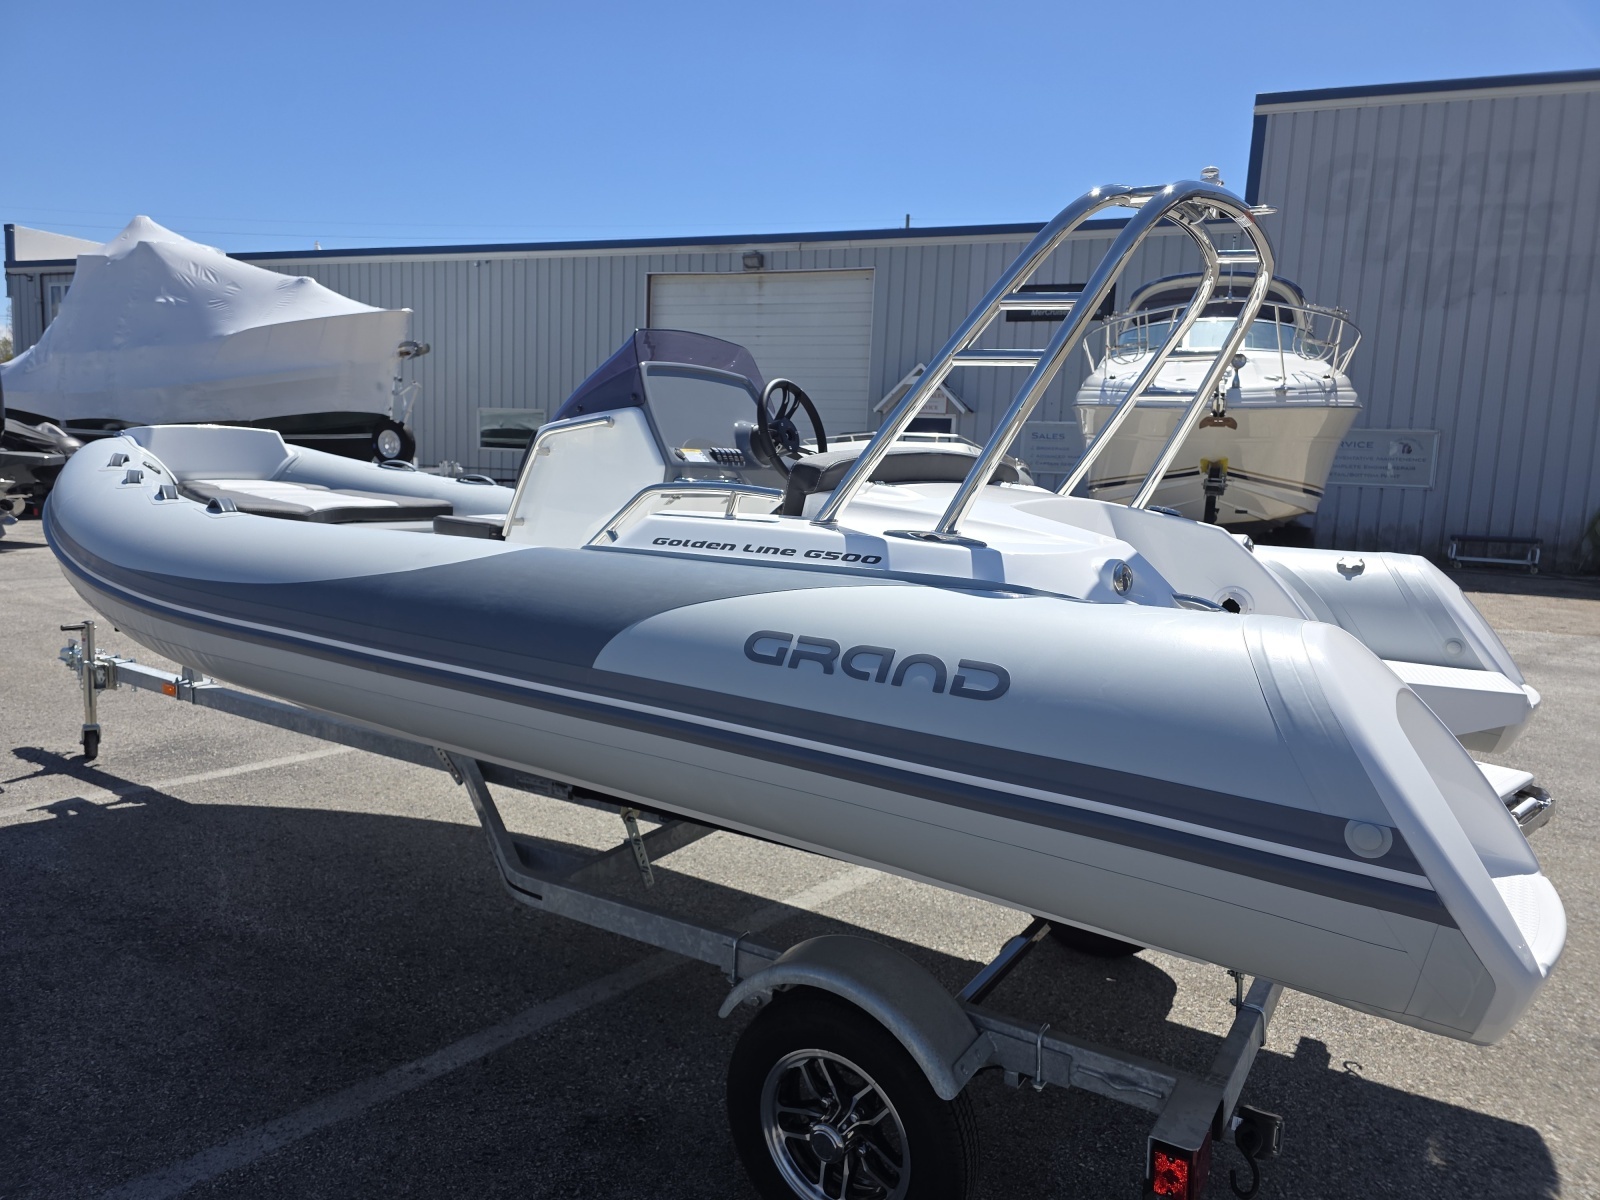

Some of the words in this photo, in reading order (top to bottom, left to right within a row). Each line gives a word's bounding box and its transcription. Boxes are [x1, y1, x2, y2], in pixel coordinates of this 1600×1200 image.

[1031, 432, 1065, 440] SALES
[803, 549, 882, 565] G500
[743, 630, 1011, 701] GRAND
